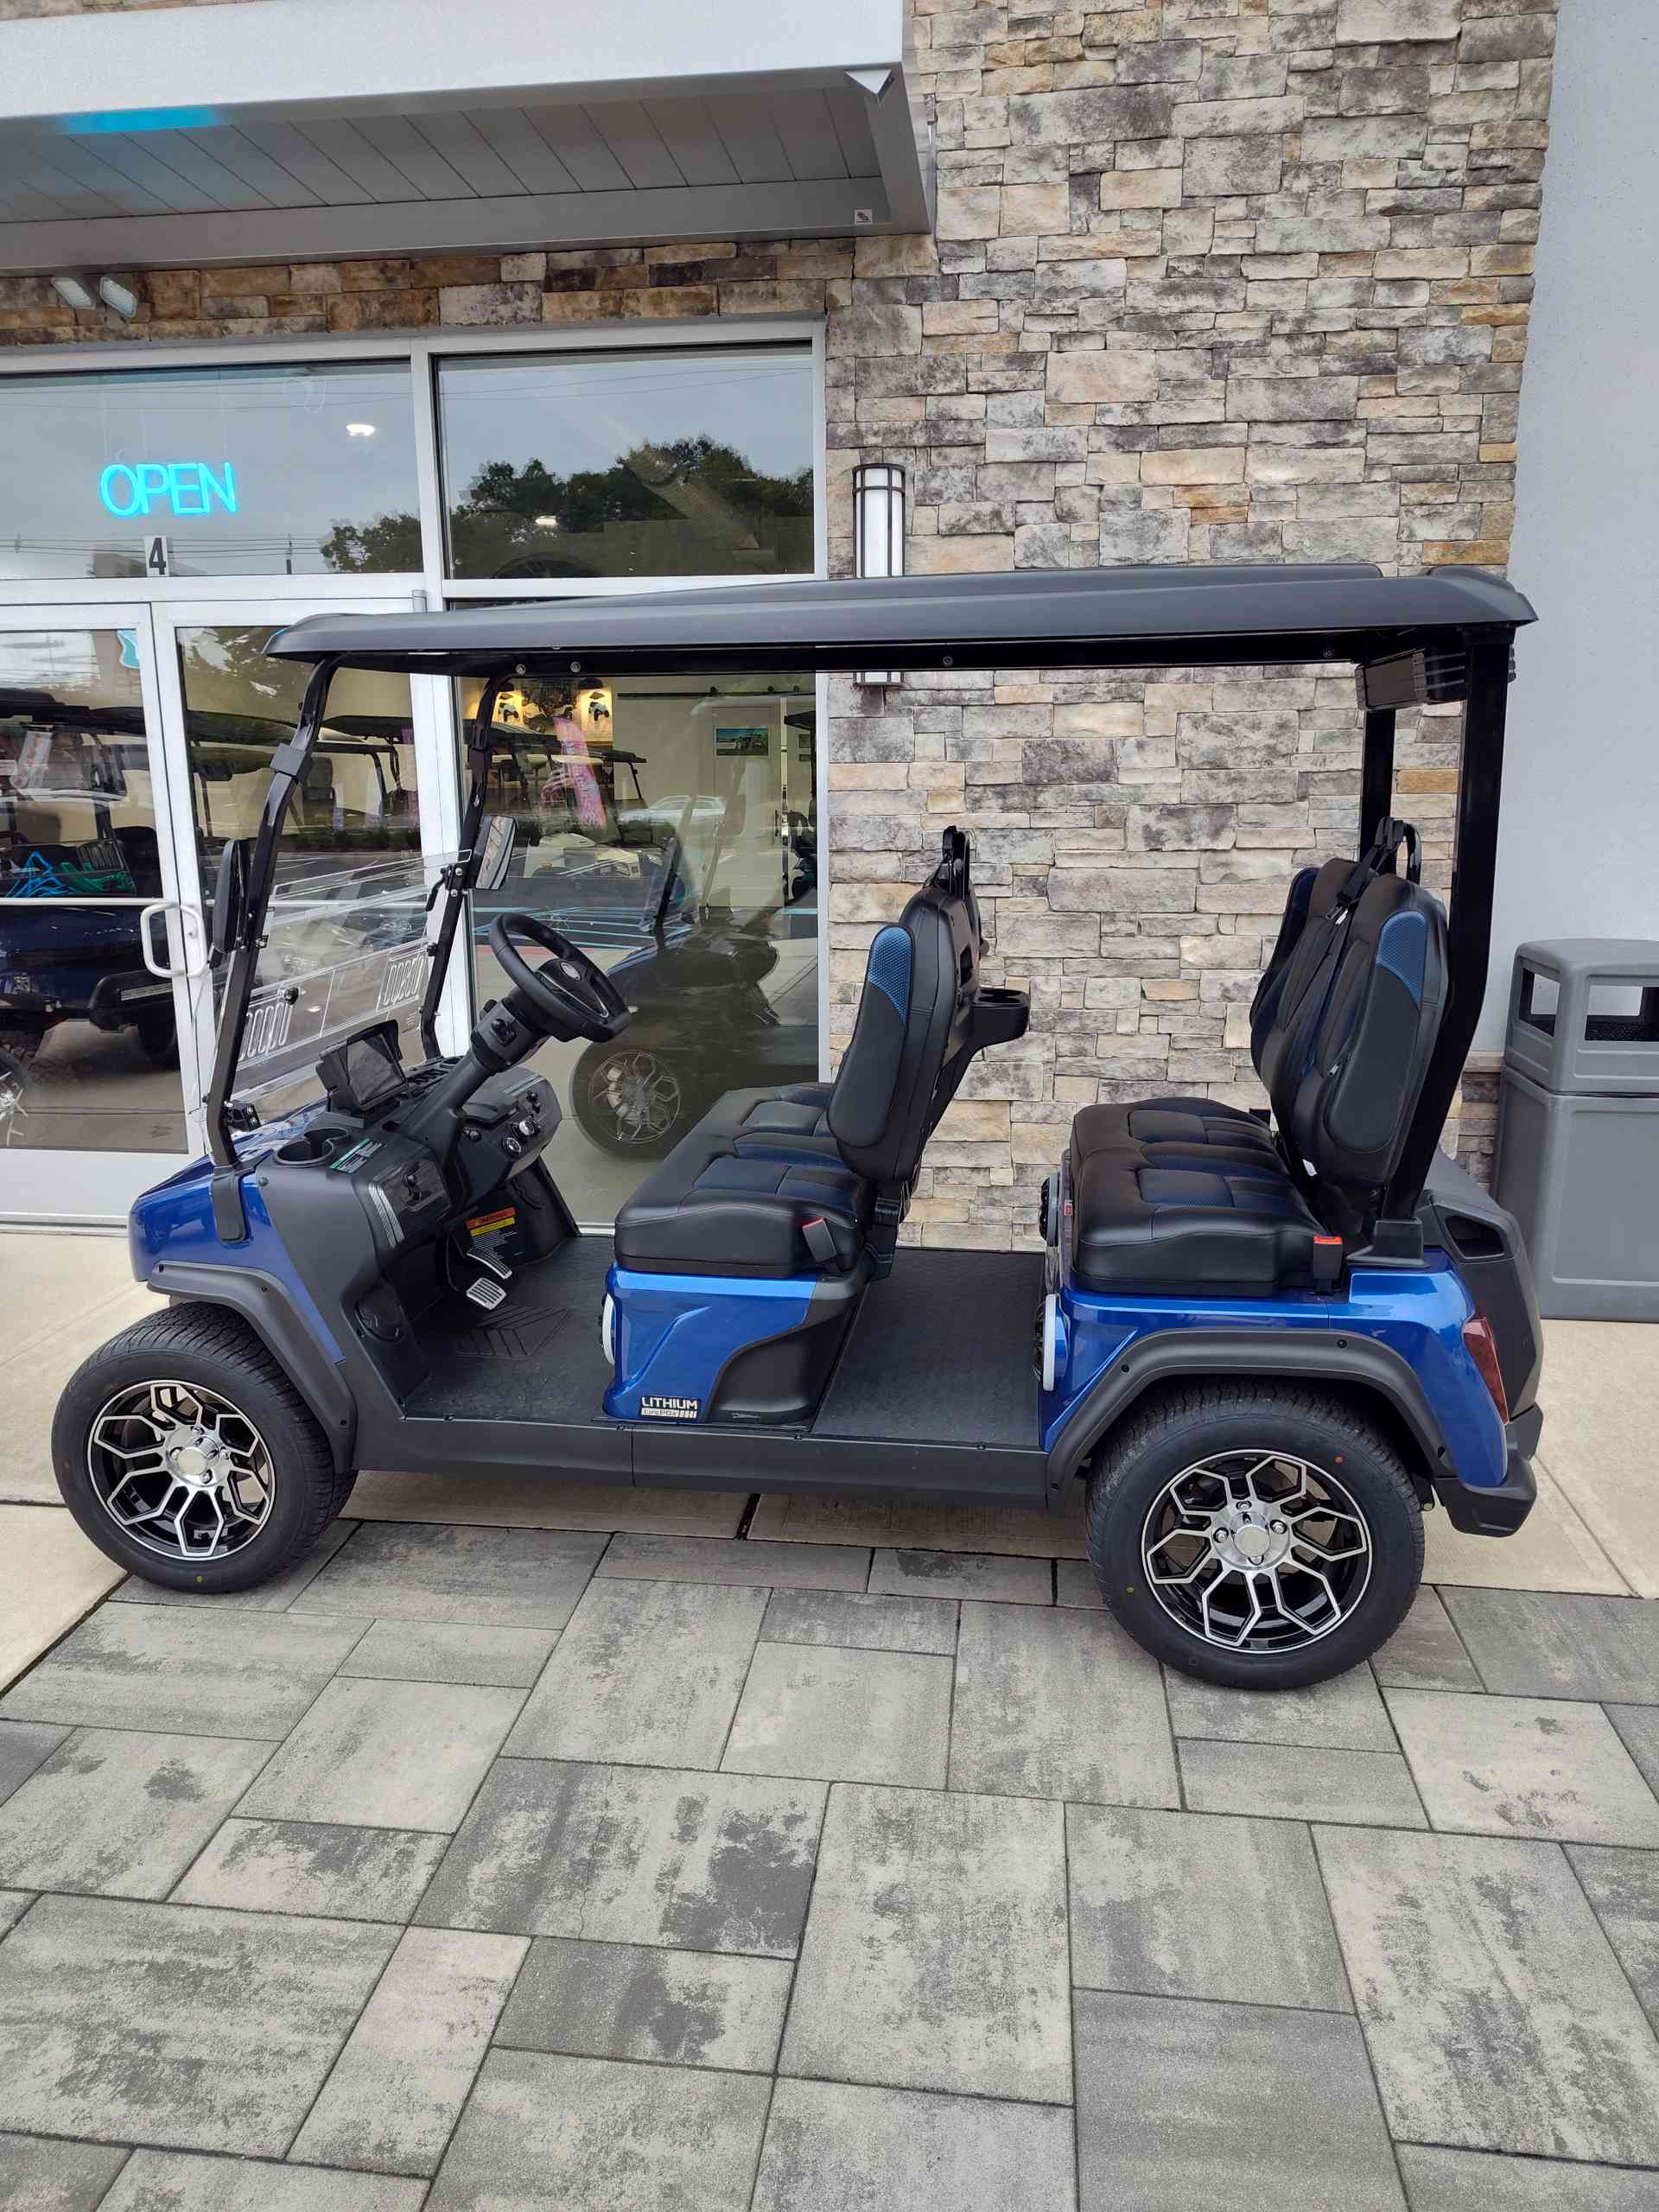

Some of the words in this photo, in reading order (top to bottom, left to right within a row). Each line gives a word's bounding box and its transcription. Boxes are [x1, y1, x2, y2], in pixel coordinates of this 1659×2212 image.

[100, 462, 237, 516] OPEN
[149, 537, 166, 575] 4
[641, 1396, 697, 1410] LITHIUM
